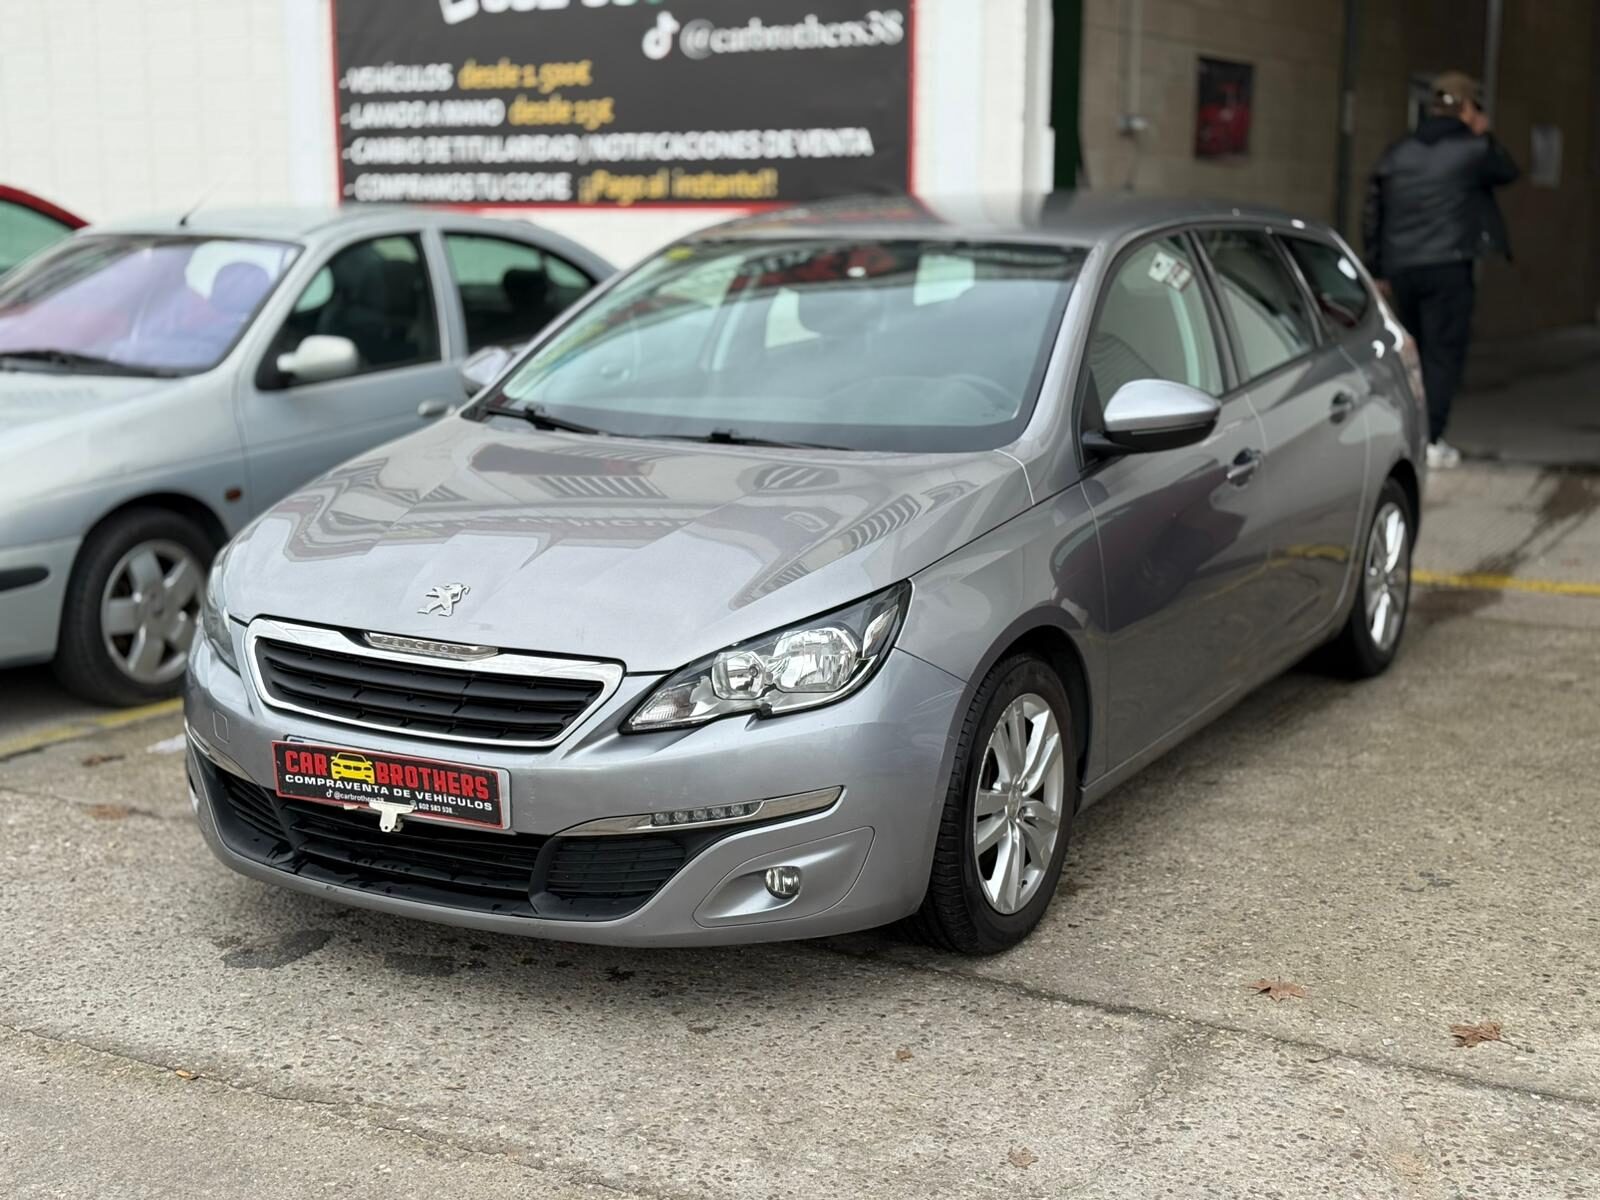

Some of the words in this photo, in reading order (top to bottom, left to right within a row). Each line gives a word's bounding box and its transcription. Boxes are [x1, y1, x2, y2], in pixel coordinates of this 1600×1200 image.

[796, 127, 875, 157] VENTA
[284, 750, 328, 776] CAR
[375, 761, 489, 801] BROTHERS
[285, 774, 389, 796] COMPRAVENTA
[393, 788, 411, 799] DE
[415, 791, 493, 811] VEHÍCULOS
